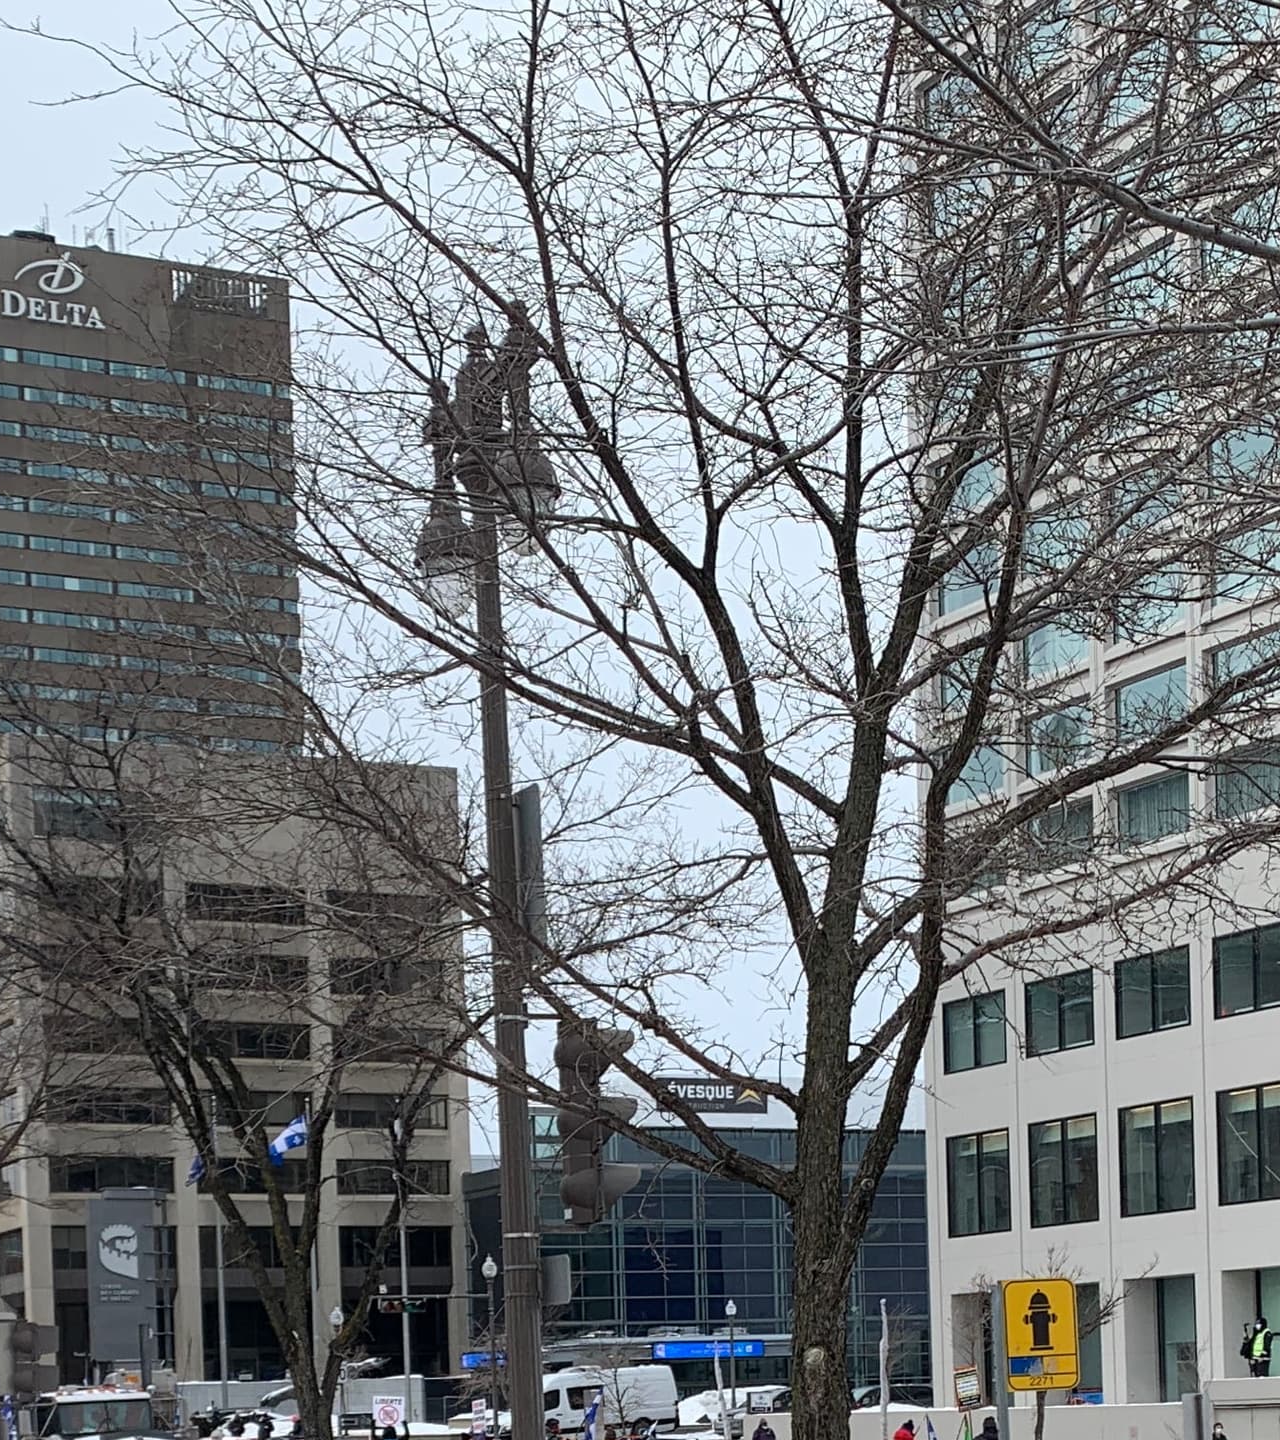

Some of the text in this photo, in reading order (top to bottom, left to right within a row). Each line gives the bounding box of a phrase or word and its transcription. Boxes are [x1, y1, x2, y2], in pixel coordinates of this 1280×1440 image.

[0, 289, 107, 330] DELTA
[667, 1080, 735, 1101] ÉVESQUE
[1029, 1375, 1055, 1387] 2271
